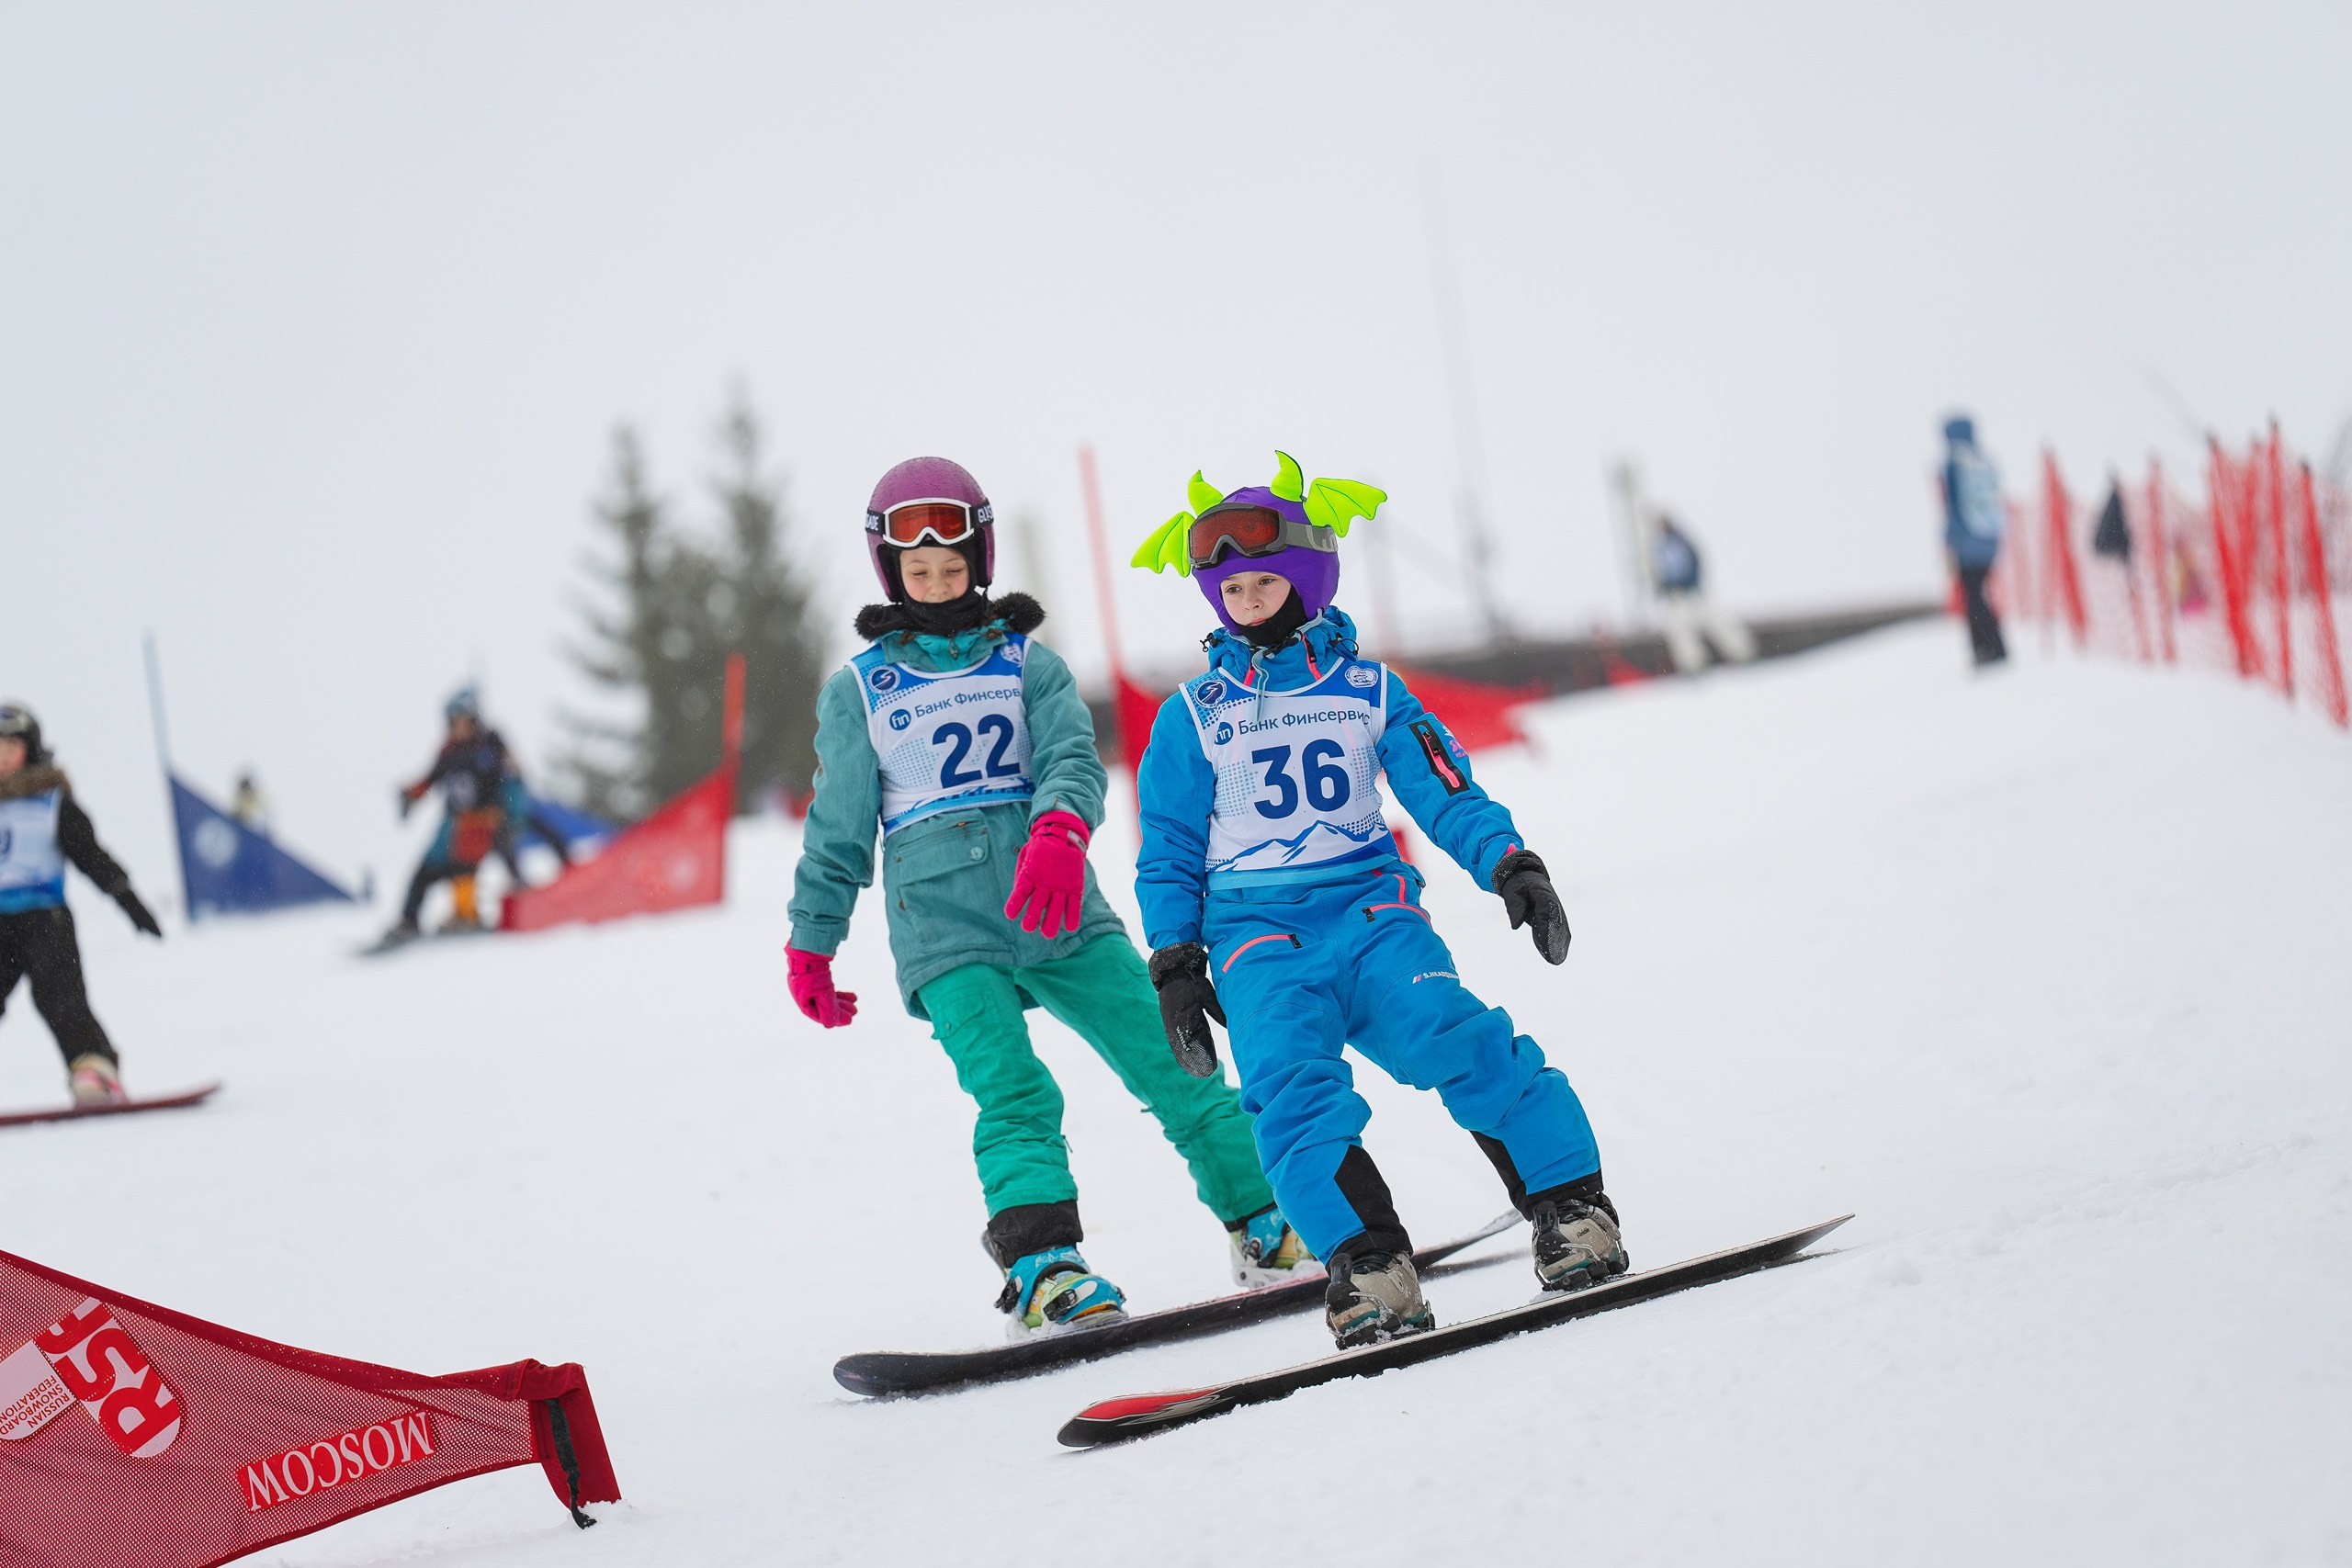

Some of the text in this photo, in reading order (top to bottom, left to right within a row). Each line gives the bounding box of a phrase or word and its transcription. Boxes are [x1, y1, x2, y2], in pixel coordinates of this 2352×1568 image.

[914, 688, 1021, 717] Банк Финсерв
[1238, 710, 1370, 735] Банк Финсервис
[932, 713, 1021, 789] 22
[1251, 739, 1351, 819] 36
[0, 1375, 57, 1423] FEDERATION
[0, 1383, 62, 1435] SNOWBOARD
[28, 1393, 70, 1428] RUSSIAN
[247, 1411, 434, 1511] MOSCOW
